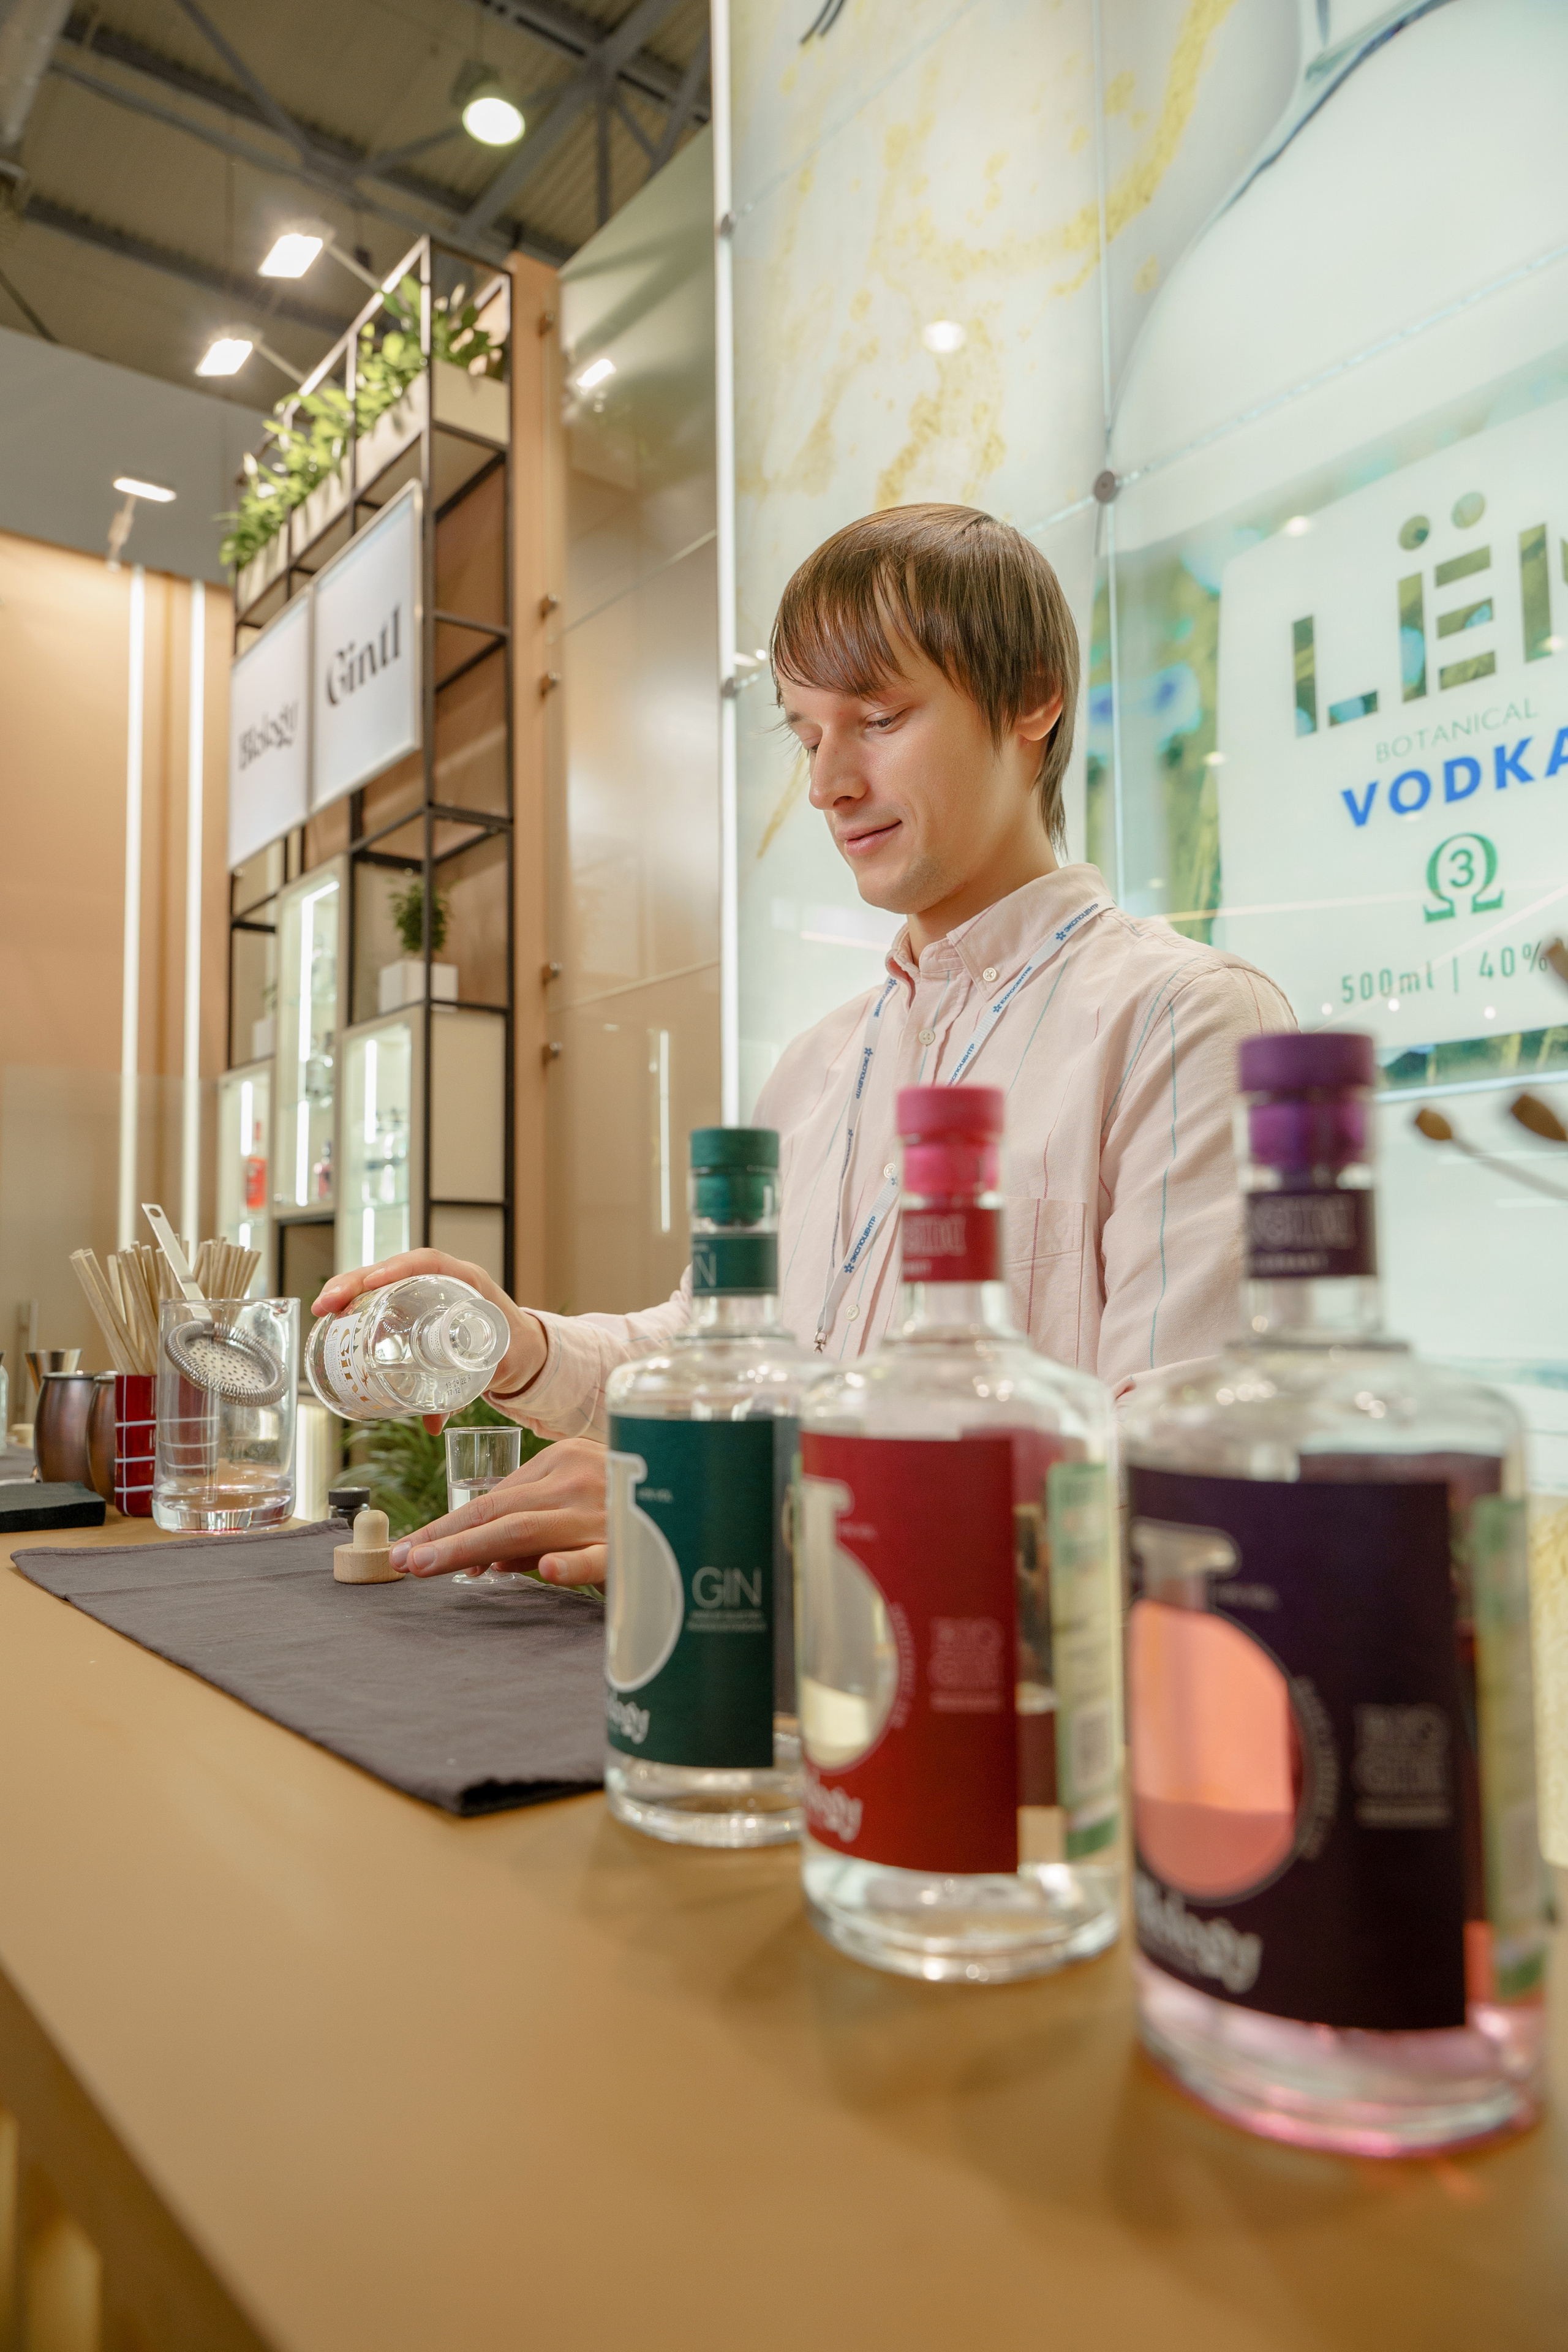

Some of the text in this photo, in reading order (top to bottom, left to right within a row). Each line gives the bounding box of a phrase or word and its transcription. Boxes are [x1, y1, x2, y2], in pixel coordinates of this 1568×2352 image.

[1376, 698, 1539, 763] BOTANICAL
[1063, 903, 1099, 933] ЭКСПОЦЕНТР
[1000, 966, 1033, 1005] EXPOCENTRE
[1341, 940, 1548, 1003] 500ml 40%
[850, 1216, 876, 1264] ЭКСПОЦЕНТР
[692, 1566, 762, 1609] GIN
